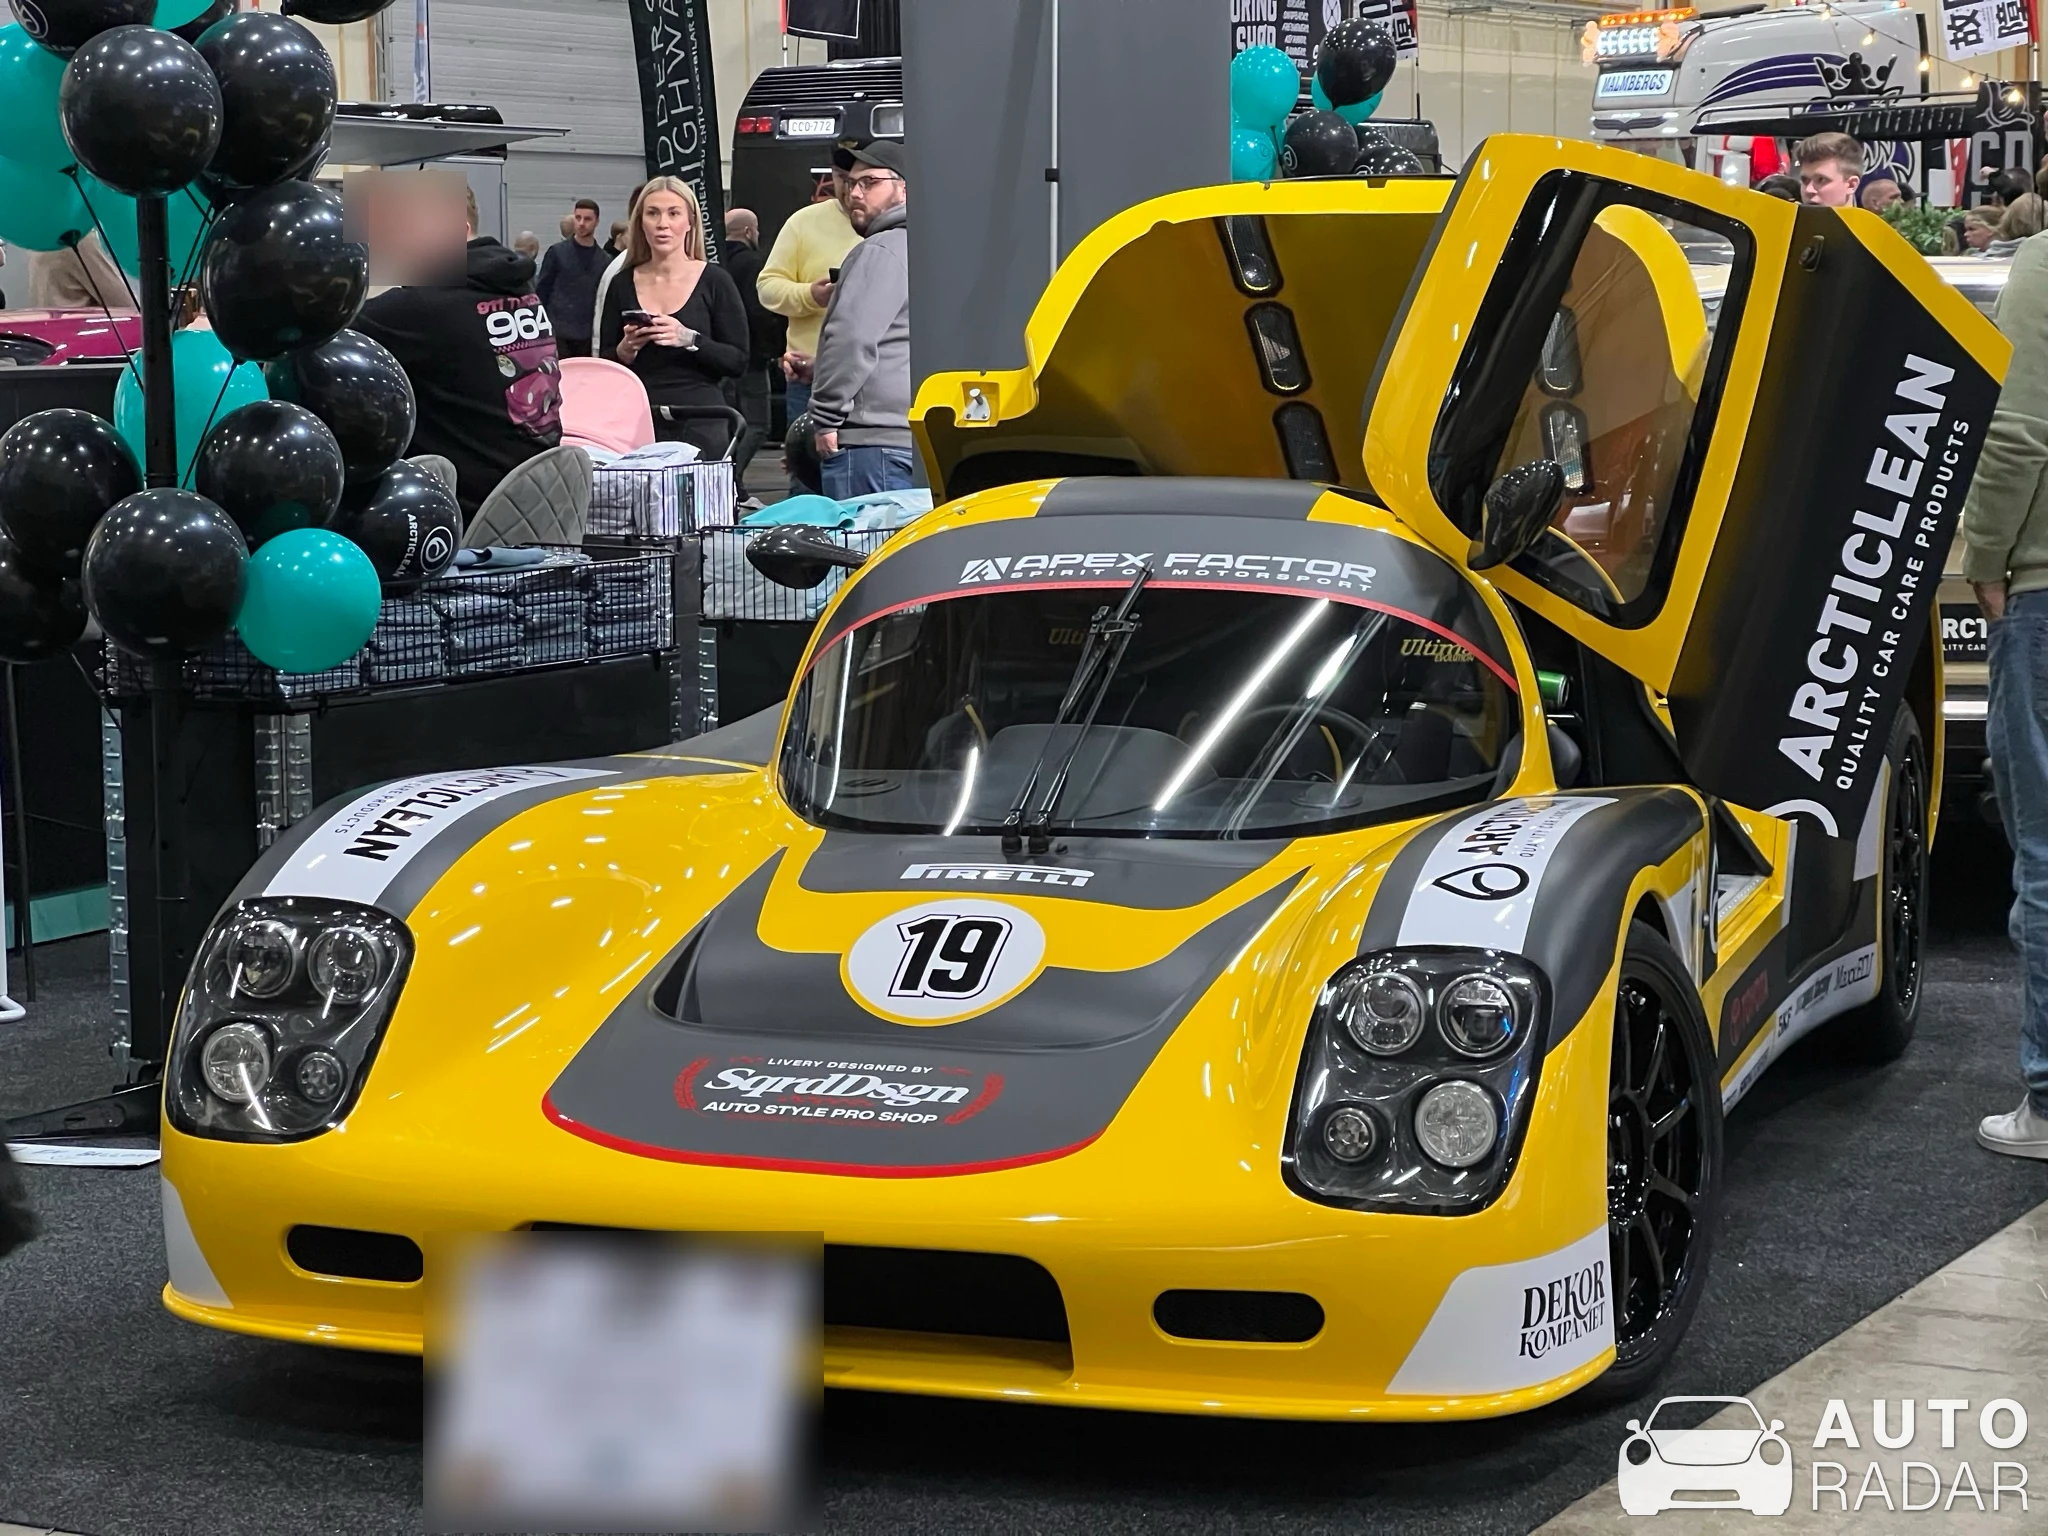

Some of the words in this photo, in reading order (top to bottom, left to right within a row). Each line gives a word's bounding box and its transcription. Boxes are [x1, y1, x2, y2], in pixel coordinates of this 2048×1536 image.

[1601, 74, 1667, 93] MALMBERGS
[486, 305, 552, 347] 964
[1010, 568, 1106, 579] SPIRIT
[1171, 568, 1373, 592] MOTORSPORT
[1013, 553, 1154, 571] APEX
[1164, 553, 1377, 583] FACTOR
[1778, 353, 1956, 782] ARCTICLEAN
[1836, 686, 1882, 791] QUALITY
[1873, 629, 1901, 678] CAR
[1891, 556, 1924, 621] CARE
[1914, 419, 1970, 549] PRODUCTS
[1941, 618, 1988, 639] RCT
[1942, 643, 1964, 651] LITY
[334, 794, 396, 835] PRODUCTS
[899, 863, 1095, 887] PIRELLI
[888, 914, 1013, 1000] 19
[767, 1057, 825, 1069] LIVERY
[826, 1061, 908, 1073] DESIGNED
[911, 1066, 934, 1074] BY
[703, 1067, 970, 1107] SqrdDsgn
[702, 1101, 761, 1114] AUTO
[763, 1104, 829, 1118] STYLE
[830, 1108, 876, 1120] PRO
[878, 1111, 938, 1125] SHOP
[1521, 1260, 1605, 1329] DEKOR
[1519, 1301, 1606, 1360] KOMPANIET
